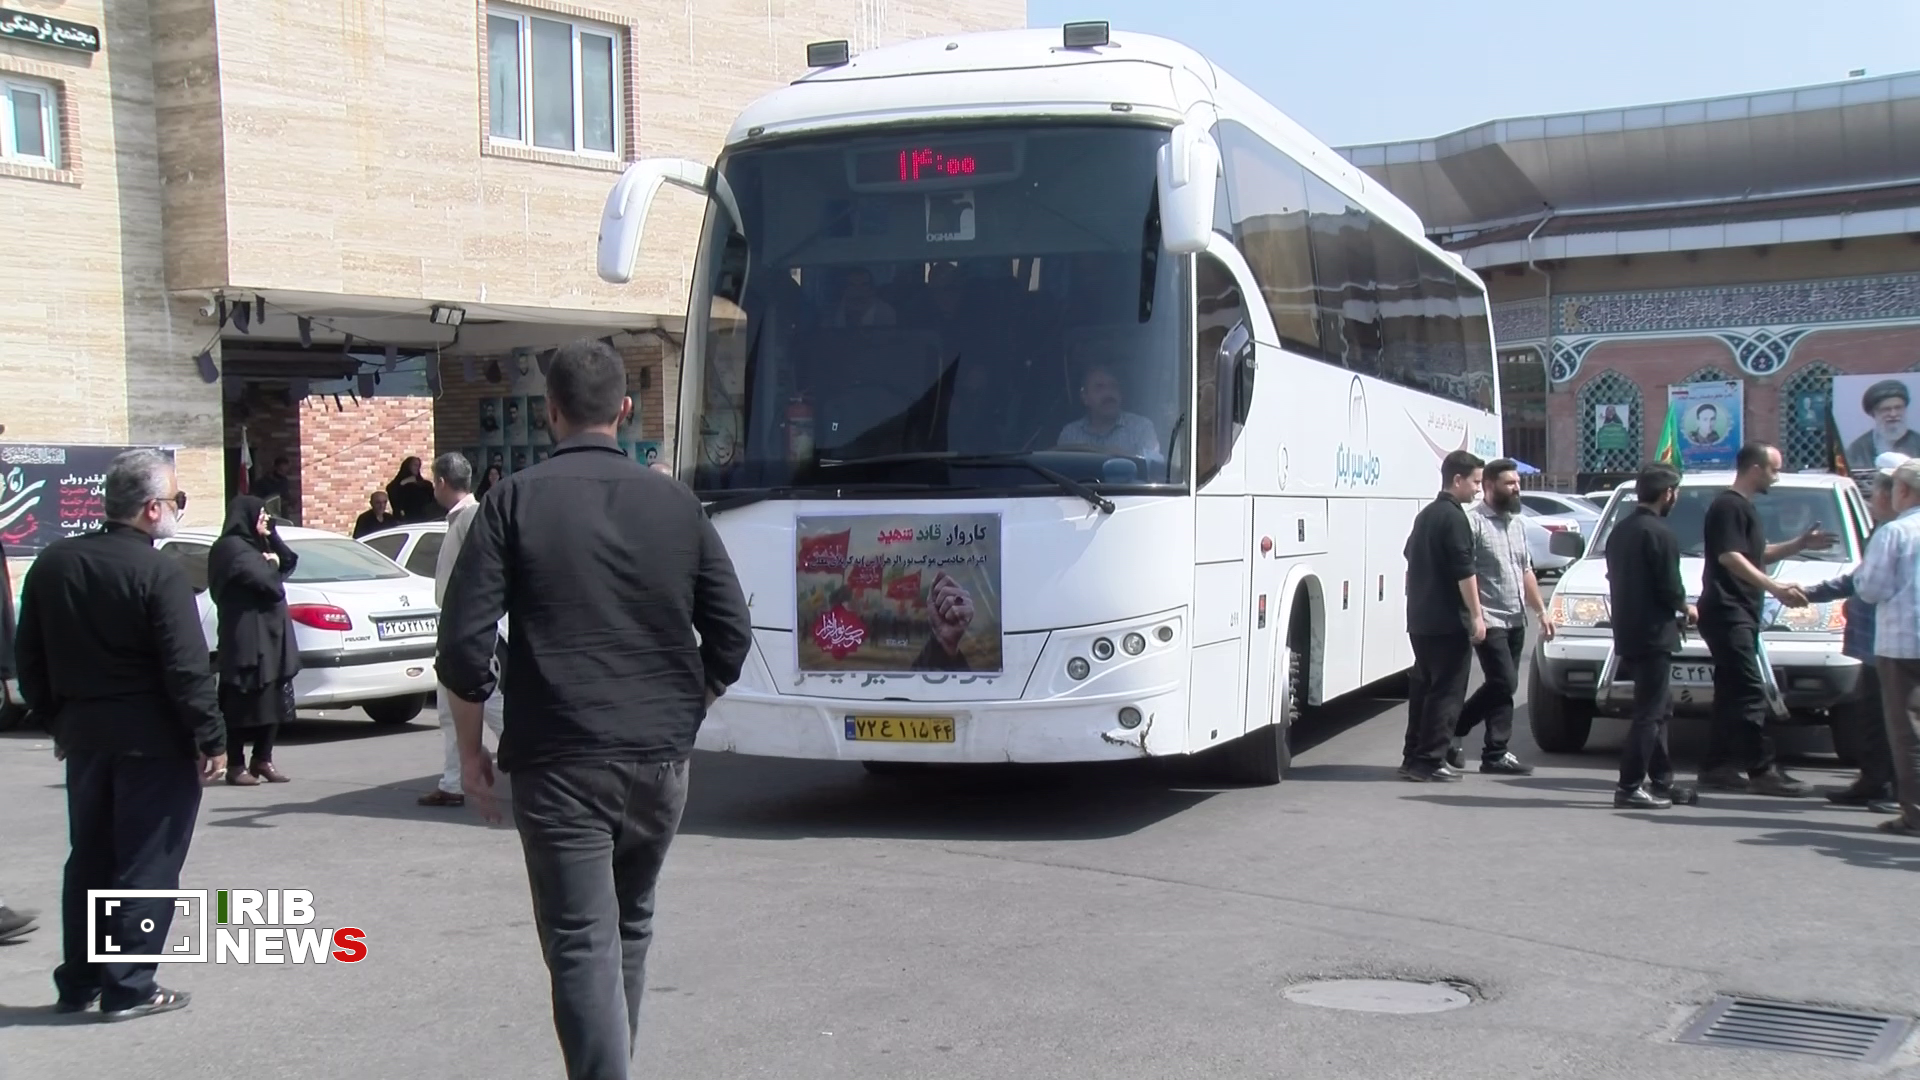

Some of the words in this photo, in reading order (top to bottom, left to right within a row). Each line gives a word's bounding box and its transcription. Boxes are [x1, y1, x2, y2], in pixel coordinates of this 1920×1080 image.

[52, 27, 96, 47] مجتمع
[84, 473, 107, 485] الیقدر
[877, 527, 914, 545] شهید
